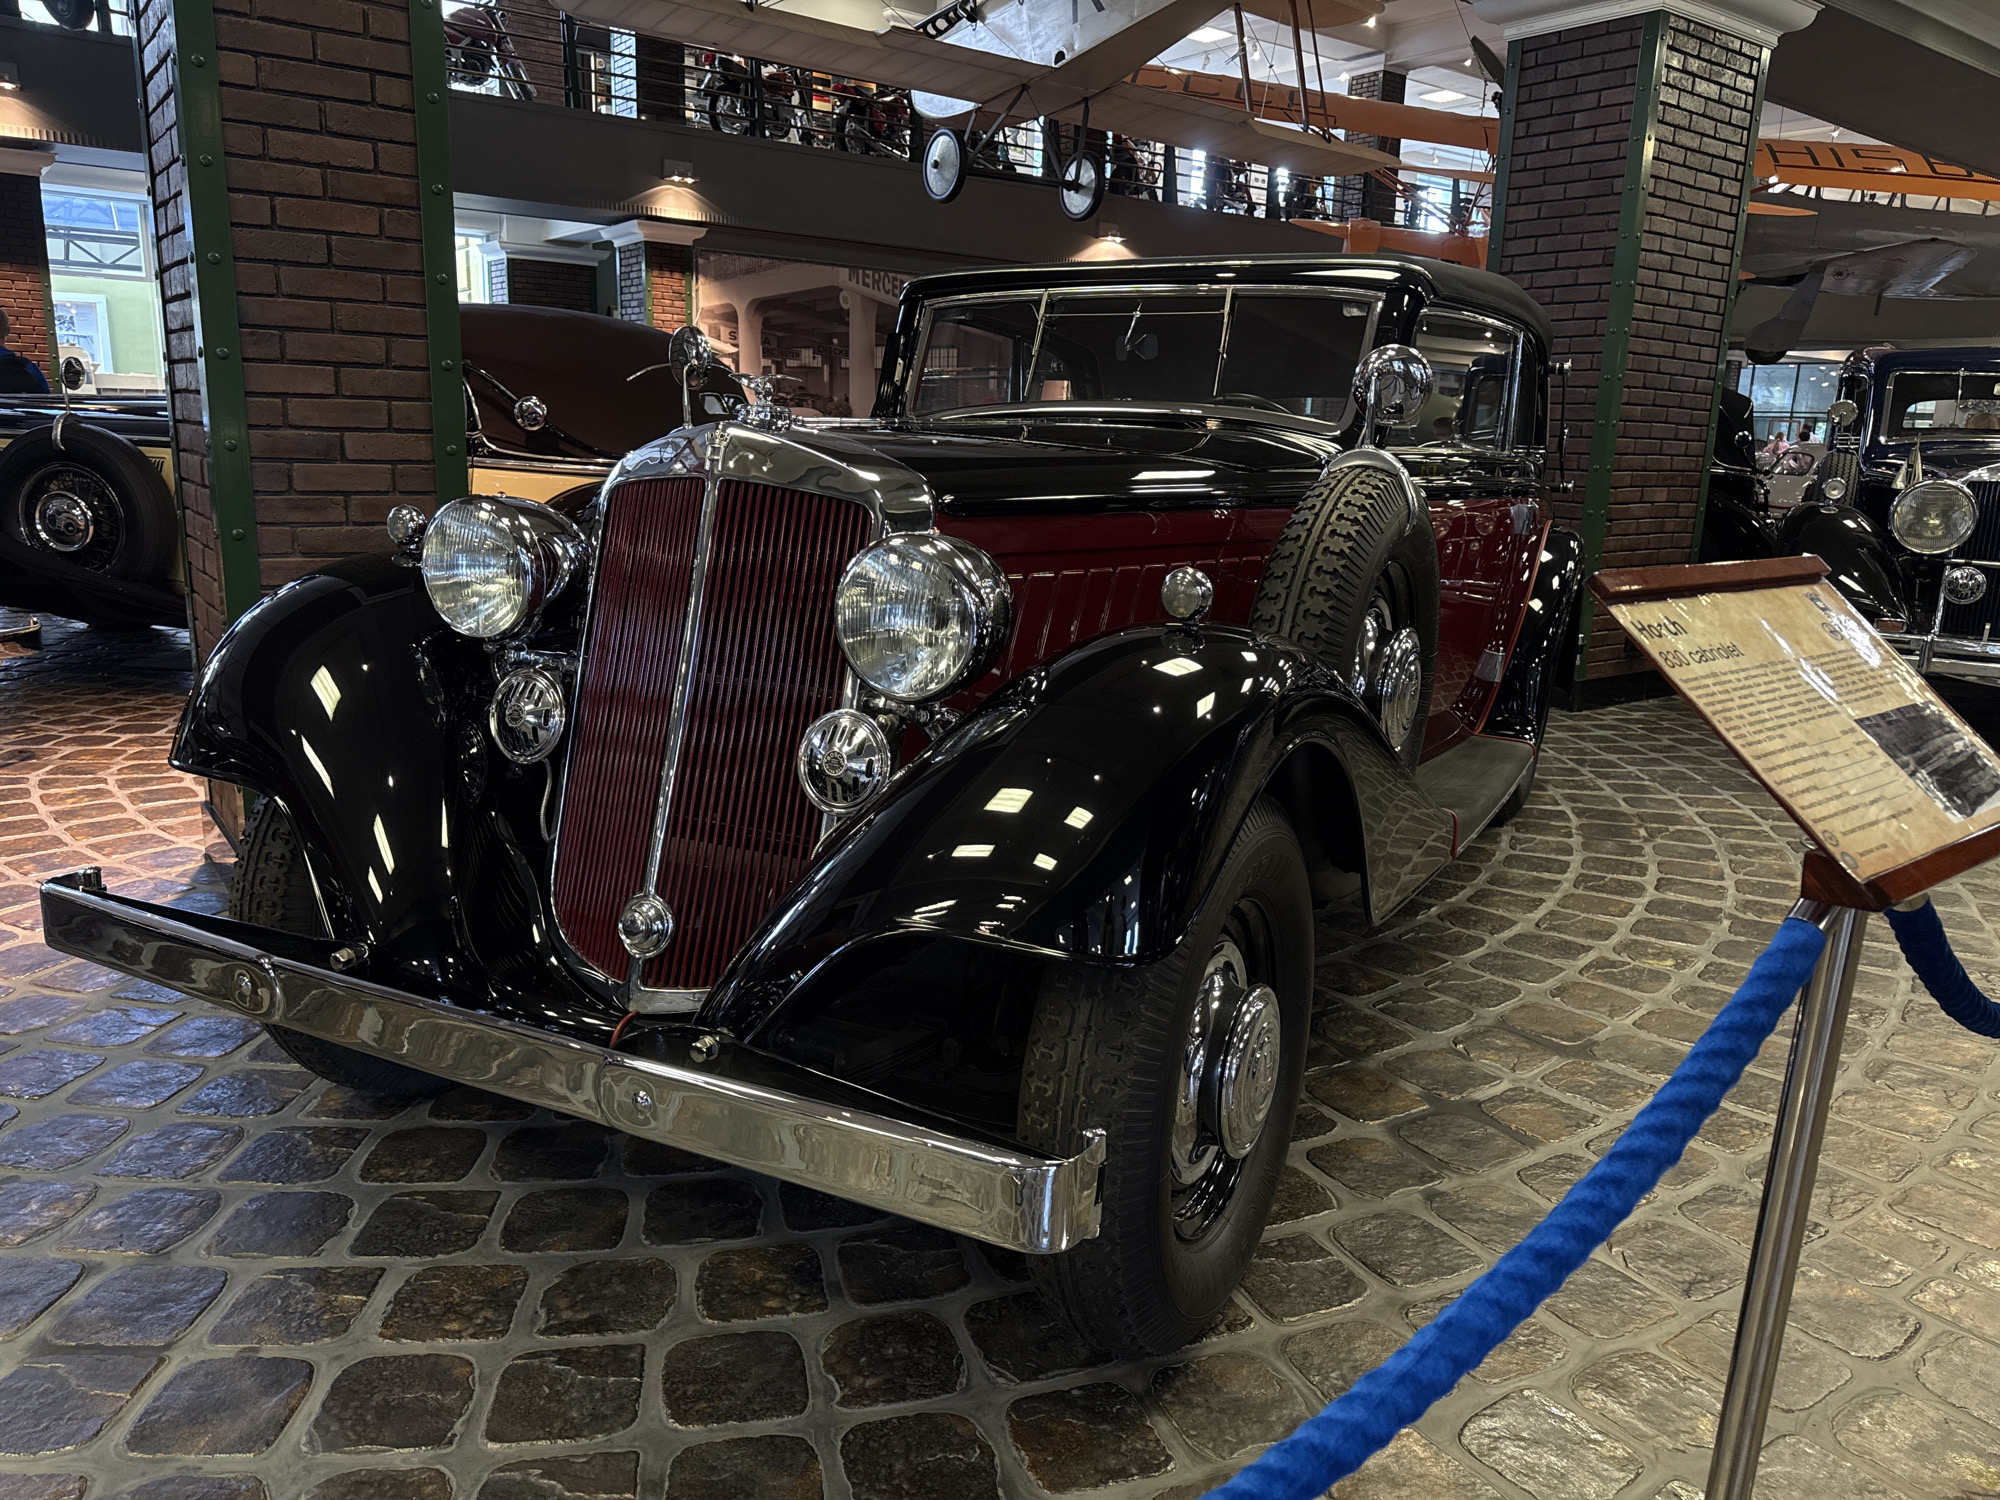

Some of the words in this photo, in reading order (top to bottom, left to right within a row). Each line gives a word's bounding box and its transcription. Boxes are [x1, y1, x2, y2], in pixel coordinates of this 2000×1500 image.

[817, 345, 849, 357] CHECKE
[1631, 616, 1687, 640] Horch
[1659, 650, 1690, 669] 830
[1689, 642, 1745, 664] cabriolet
